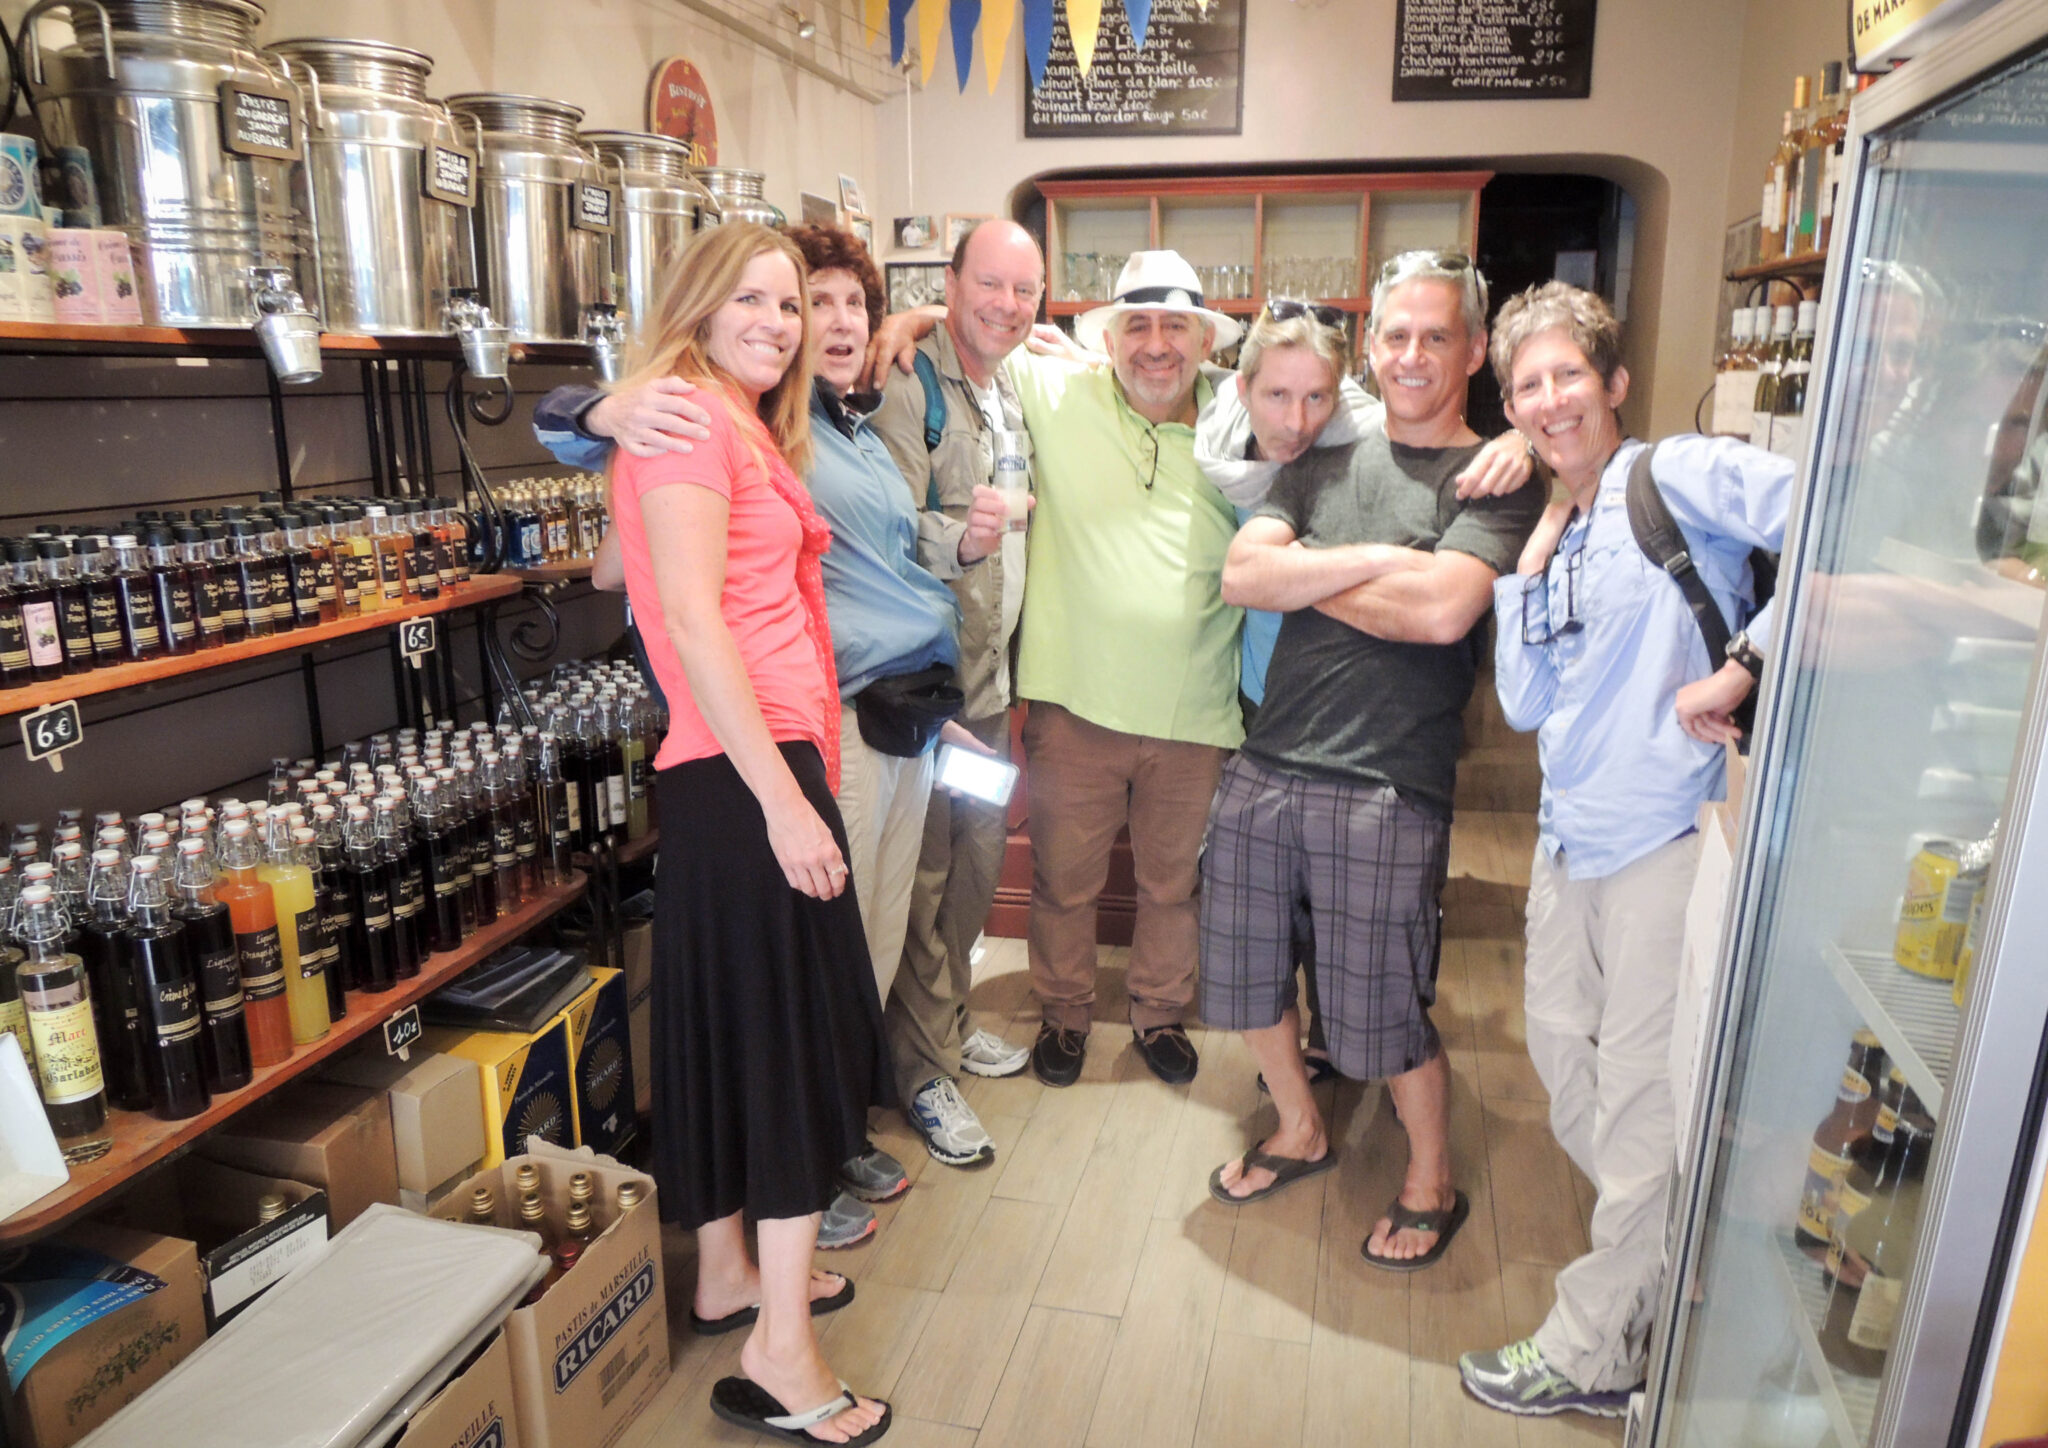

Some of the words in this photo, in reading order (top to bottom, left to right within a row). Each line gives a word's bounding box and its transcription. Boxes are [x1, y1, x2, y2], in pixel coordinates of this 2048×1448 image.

[1856, 9, 1871, 37] DE
[1039, 77, 1082, 89] uinart
[408, 625, 428, 649] 6€
[37, 716, 72, 748] 6€
[48, 1028, 88, 1047] Marc
[555, 1305, 588, 1350] PASTIS
[589, 1301, 599, 1314] de
[600, 1244, 650, 1300] MARSEILLE
[558, 1272, 651, 1384] RICARD
